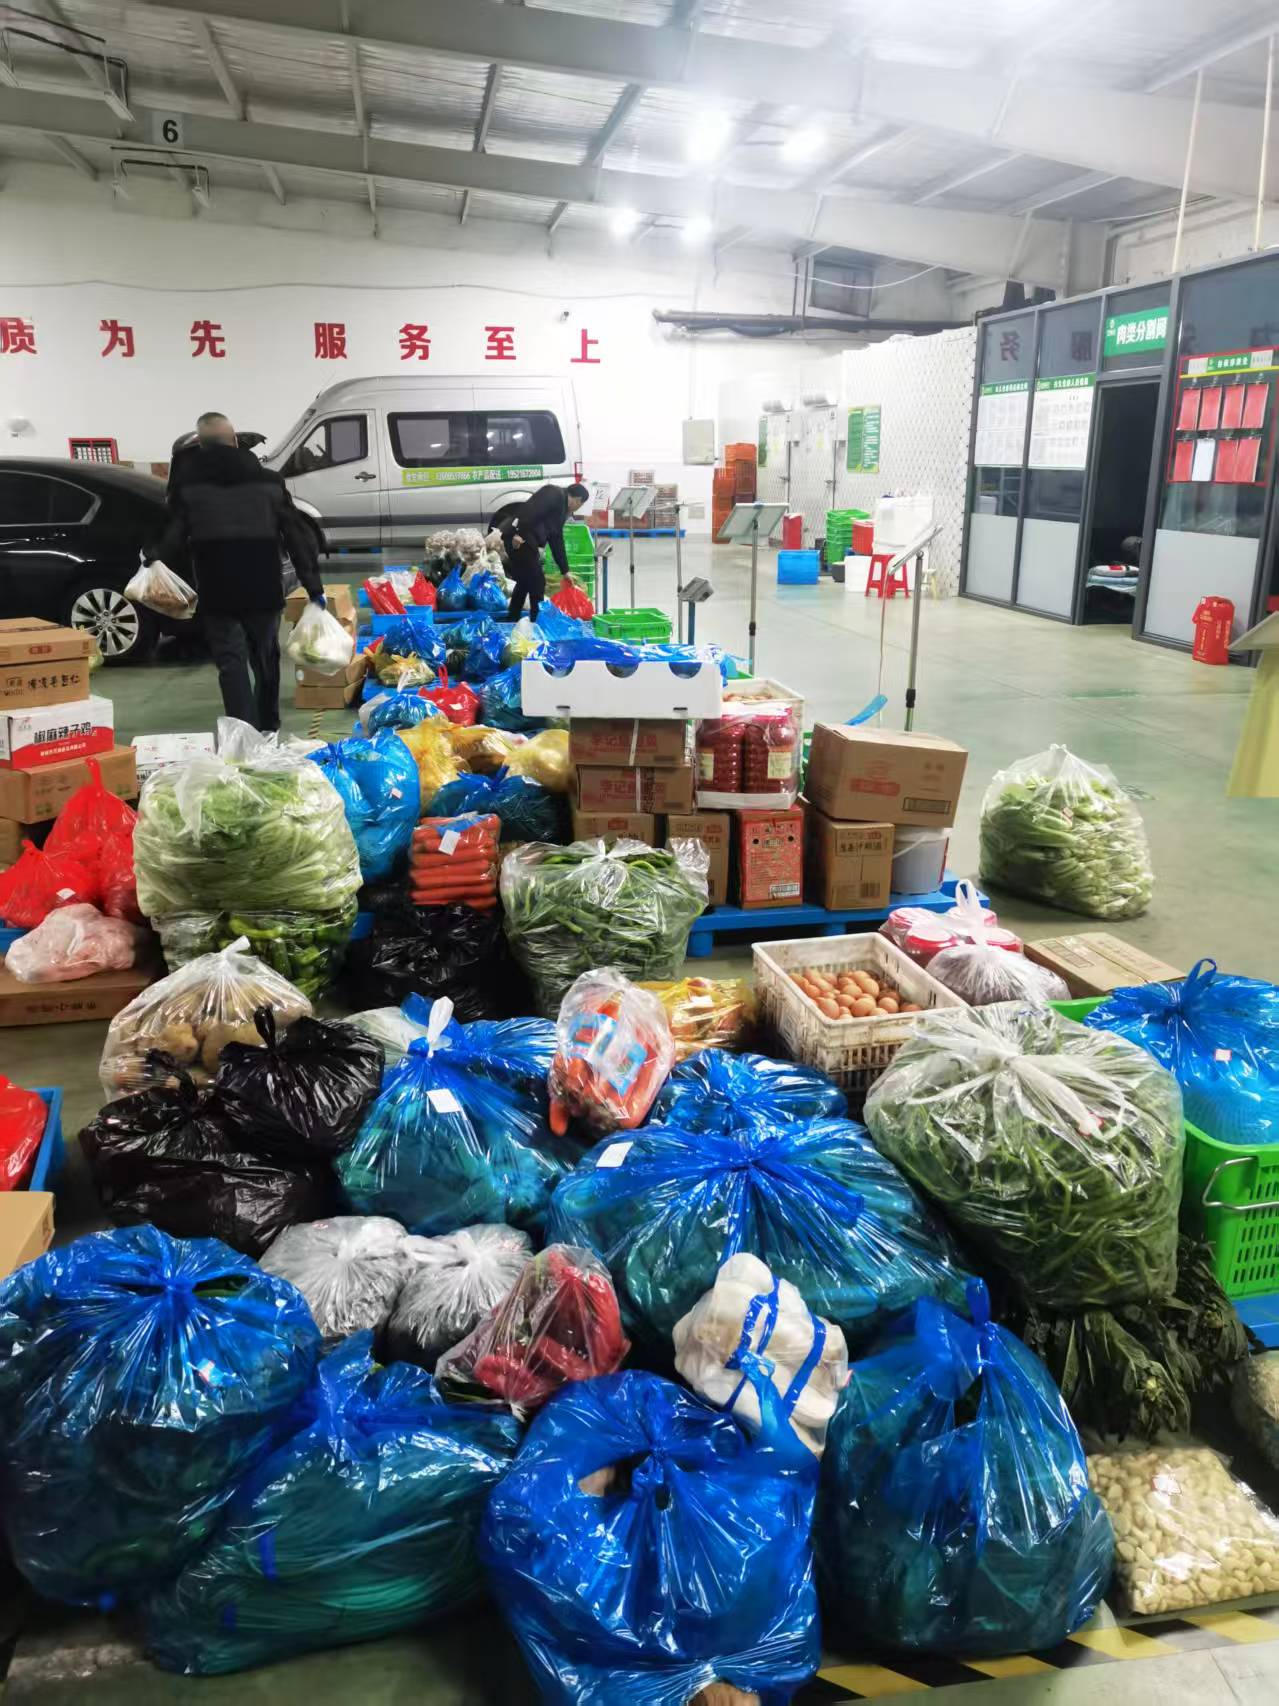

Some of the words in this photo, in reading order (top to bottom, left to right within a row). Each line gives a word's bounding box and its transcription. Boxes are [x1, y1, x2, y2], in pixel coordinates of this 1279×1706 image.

[162, 119, 179, 144] 6
[314, 322, 601, 364] 服务至上
